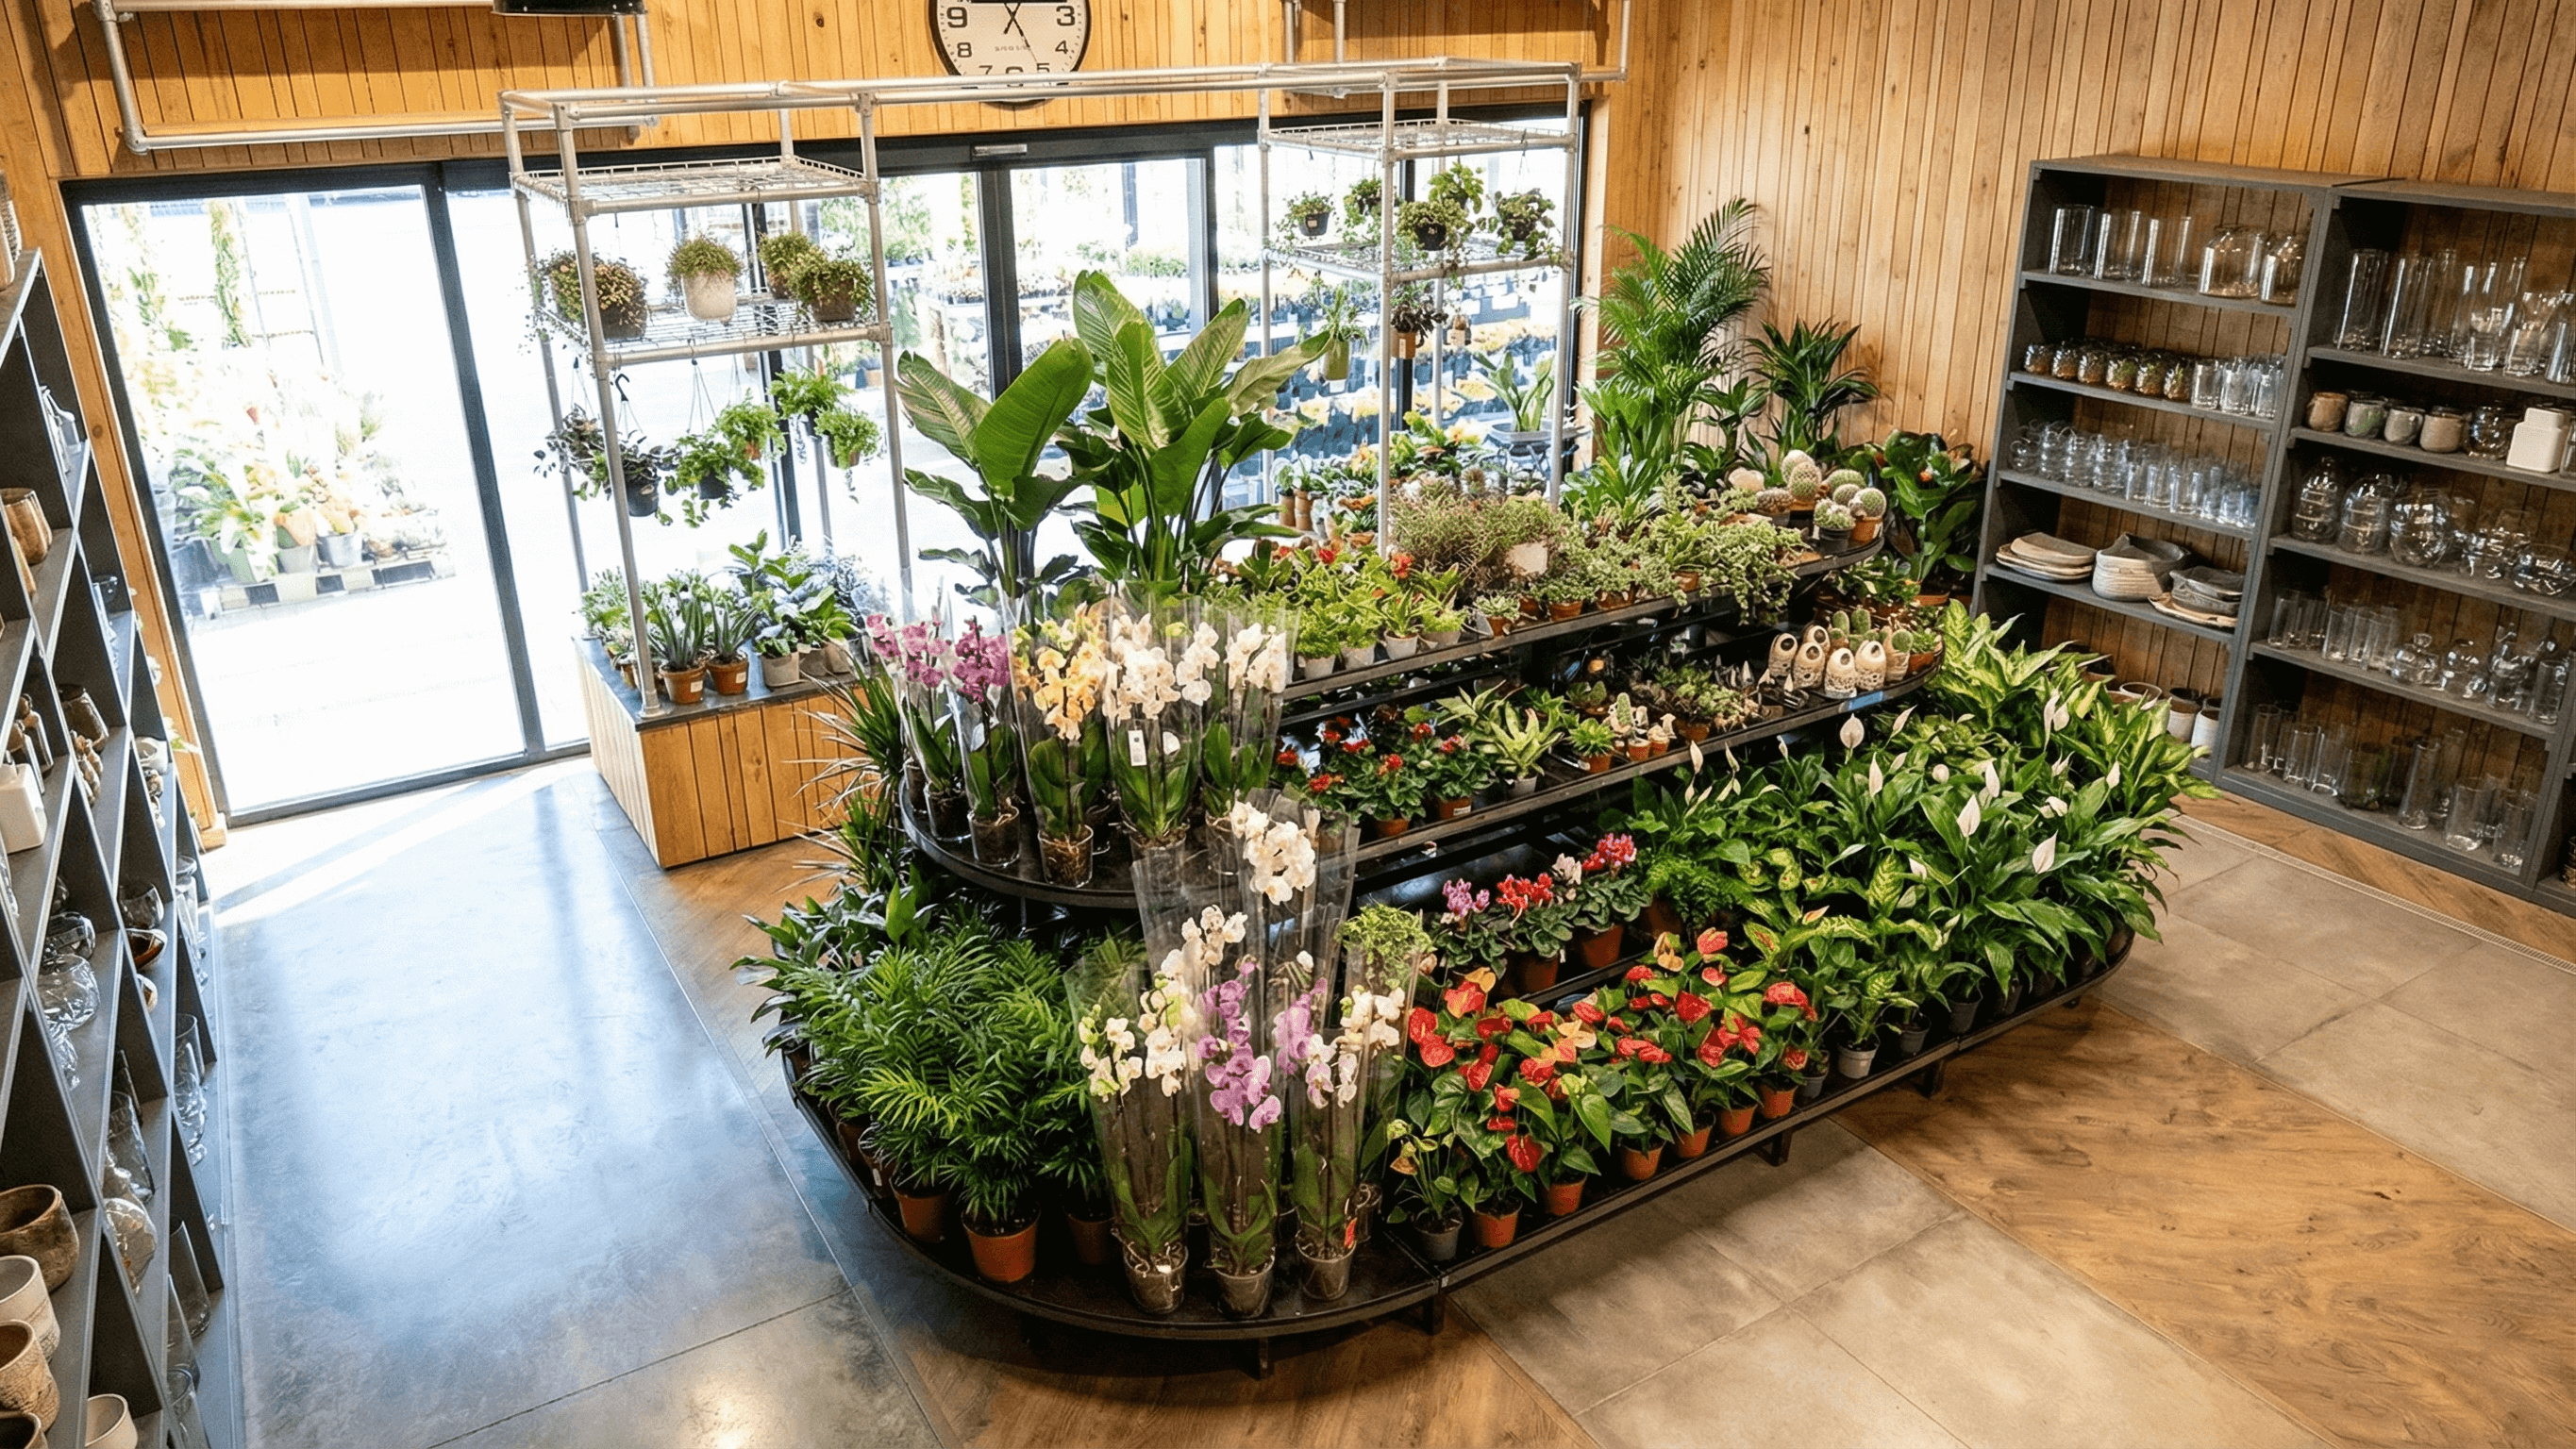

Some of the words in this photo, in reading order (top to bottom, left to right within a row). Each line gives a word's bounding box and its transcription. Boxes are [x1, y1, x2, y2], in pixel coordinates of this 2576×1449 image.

[946, 7, 968, 28] 9
[1056, 5, 1076, 26] 3
[957, 42, 973, 58] 8
[1055, 41, 1069, 55] 4
